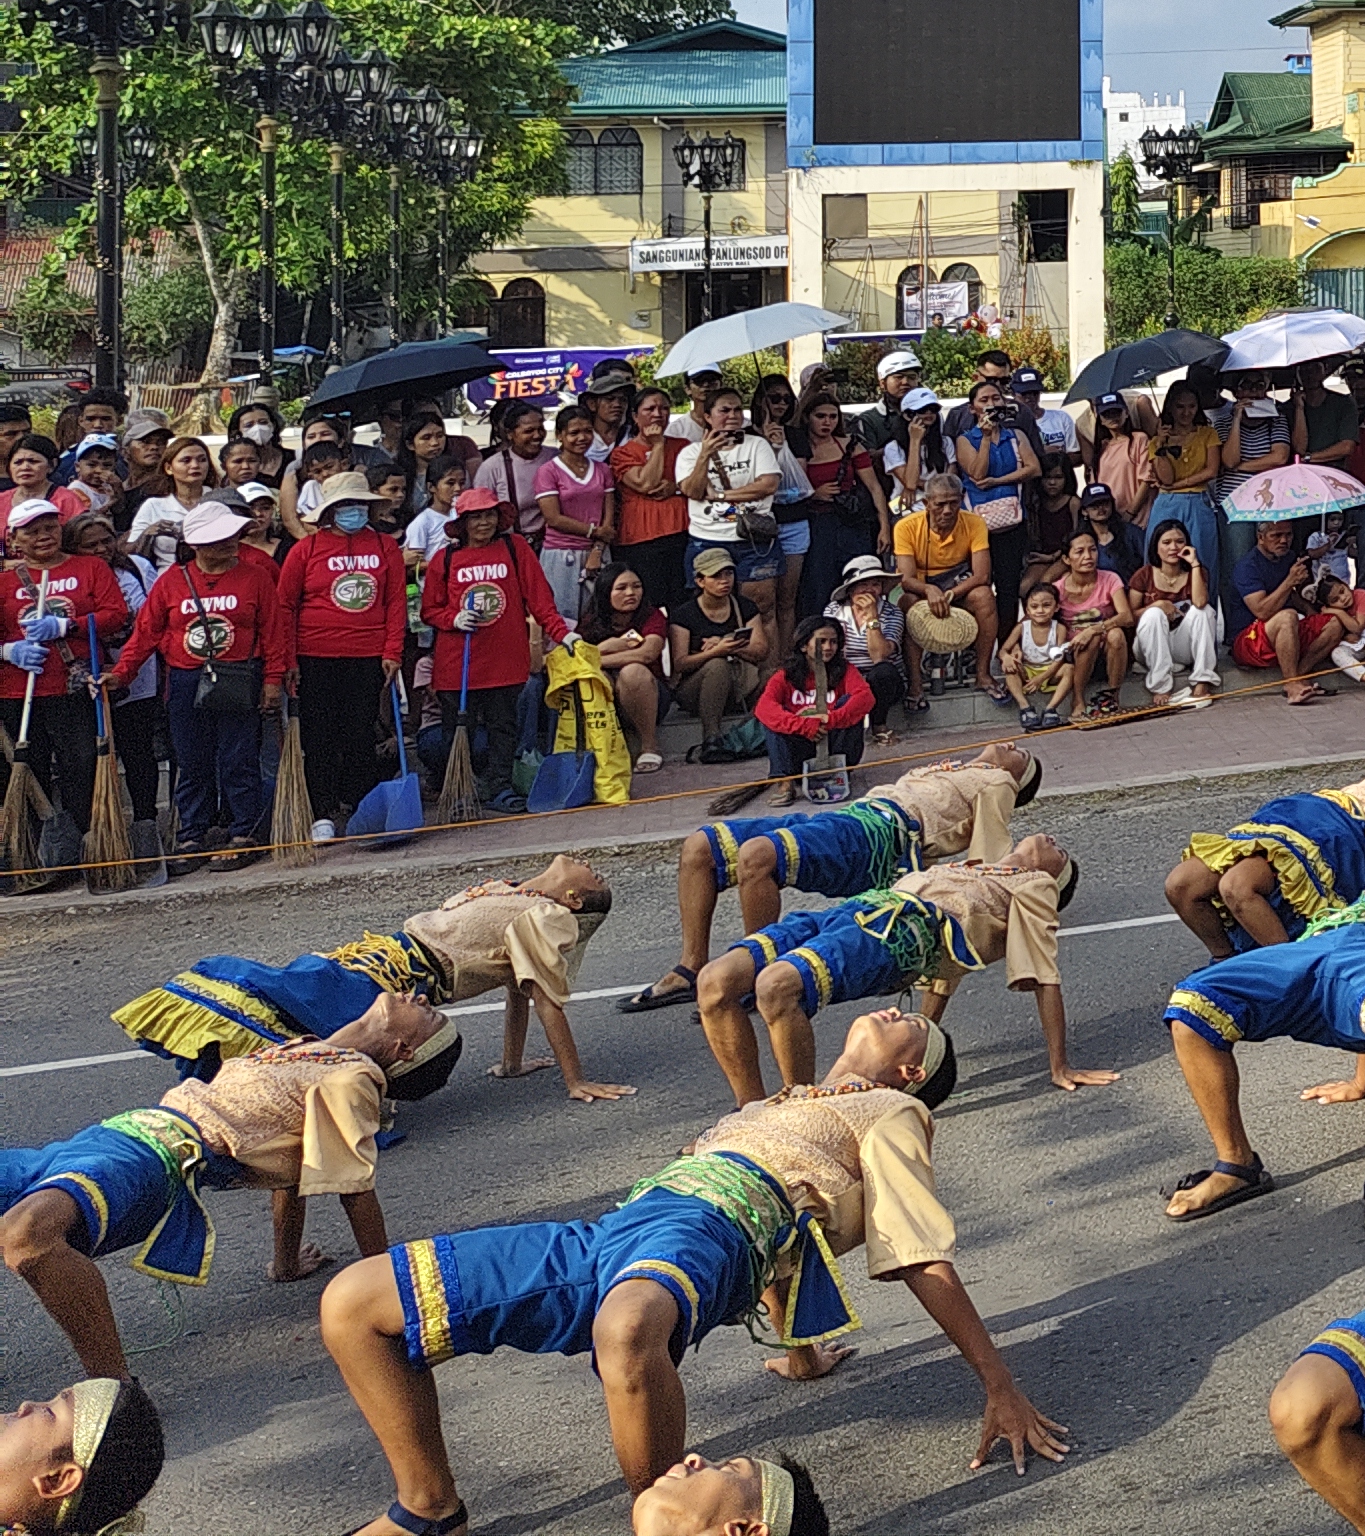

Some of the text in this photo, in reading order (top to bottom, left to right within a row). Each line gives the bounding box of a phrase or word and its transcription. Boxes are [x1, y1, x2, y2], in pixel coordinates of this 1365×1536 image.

[711, 245, 772, 262] PANLUNGSOD
[493, 373, 577, 400] FIESTA
[328, 554, 380, 571] CSWMO
[457, 563, 508, 583] CSWMO
[181, 595, 238, 615] CSWMO
